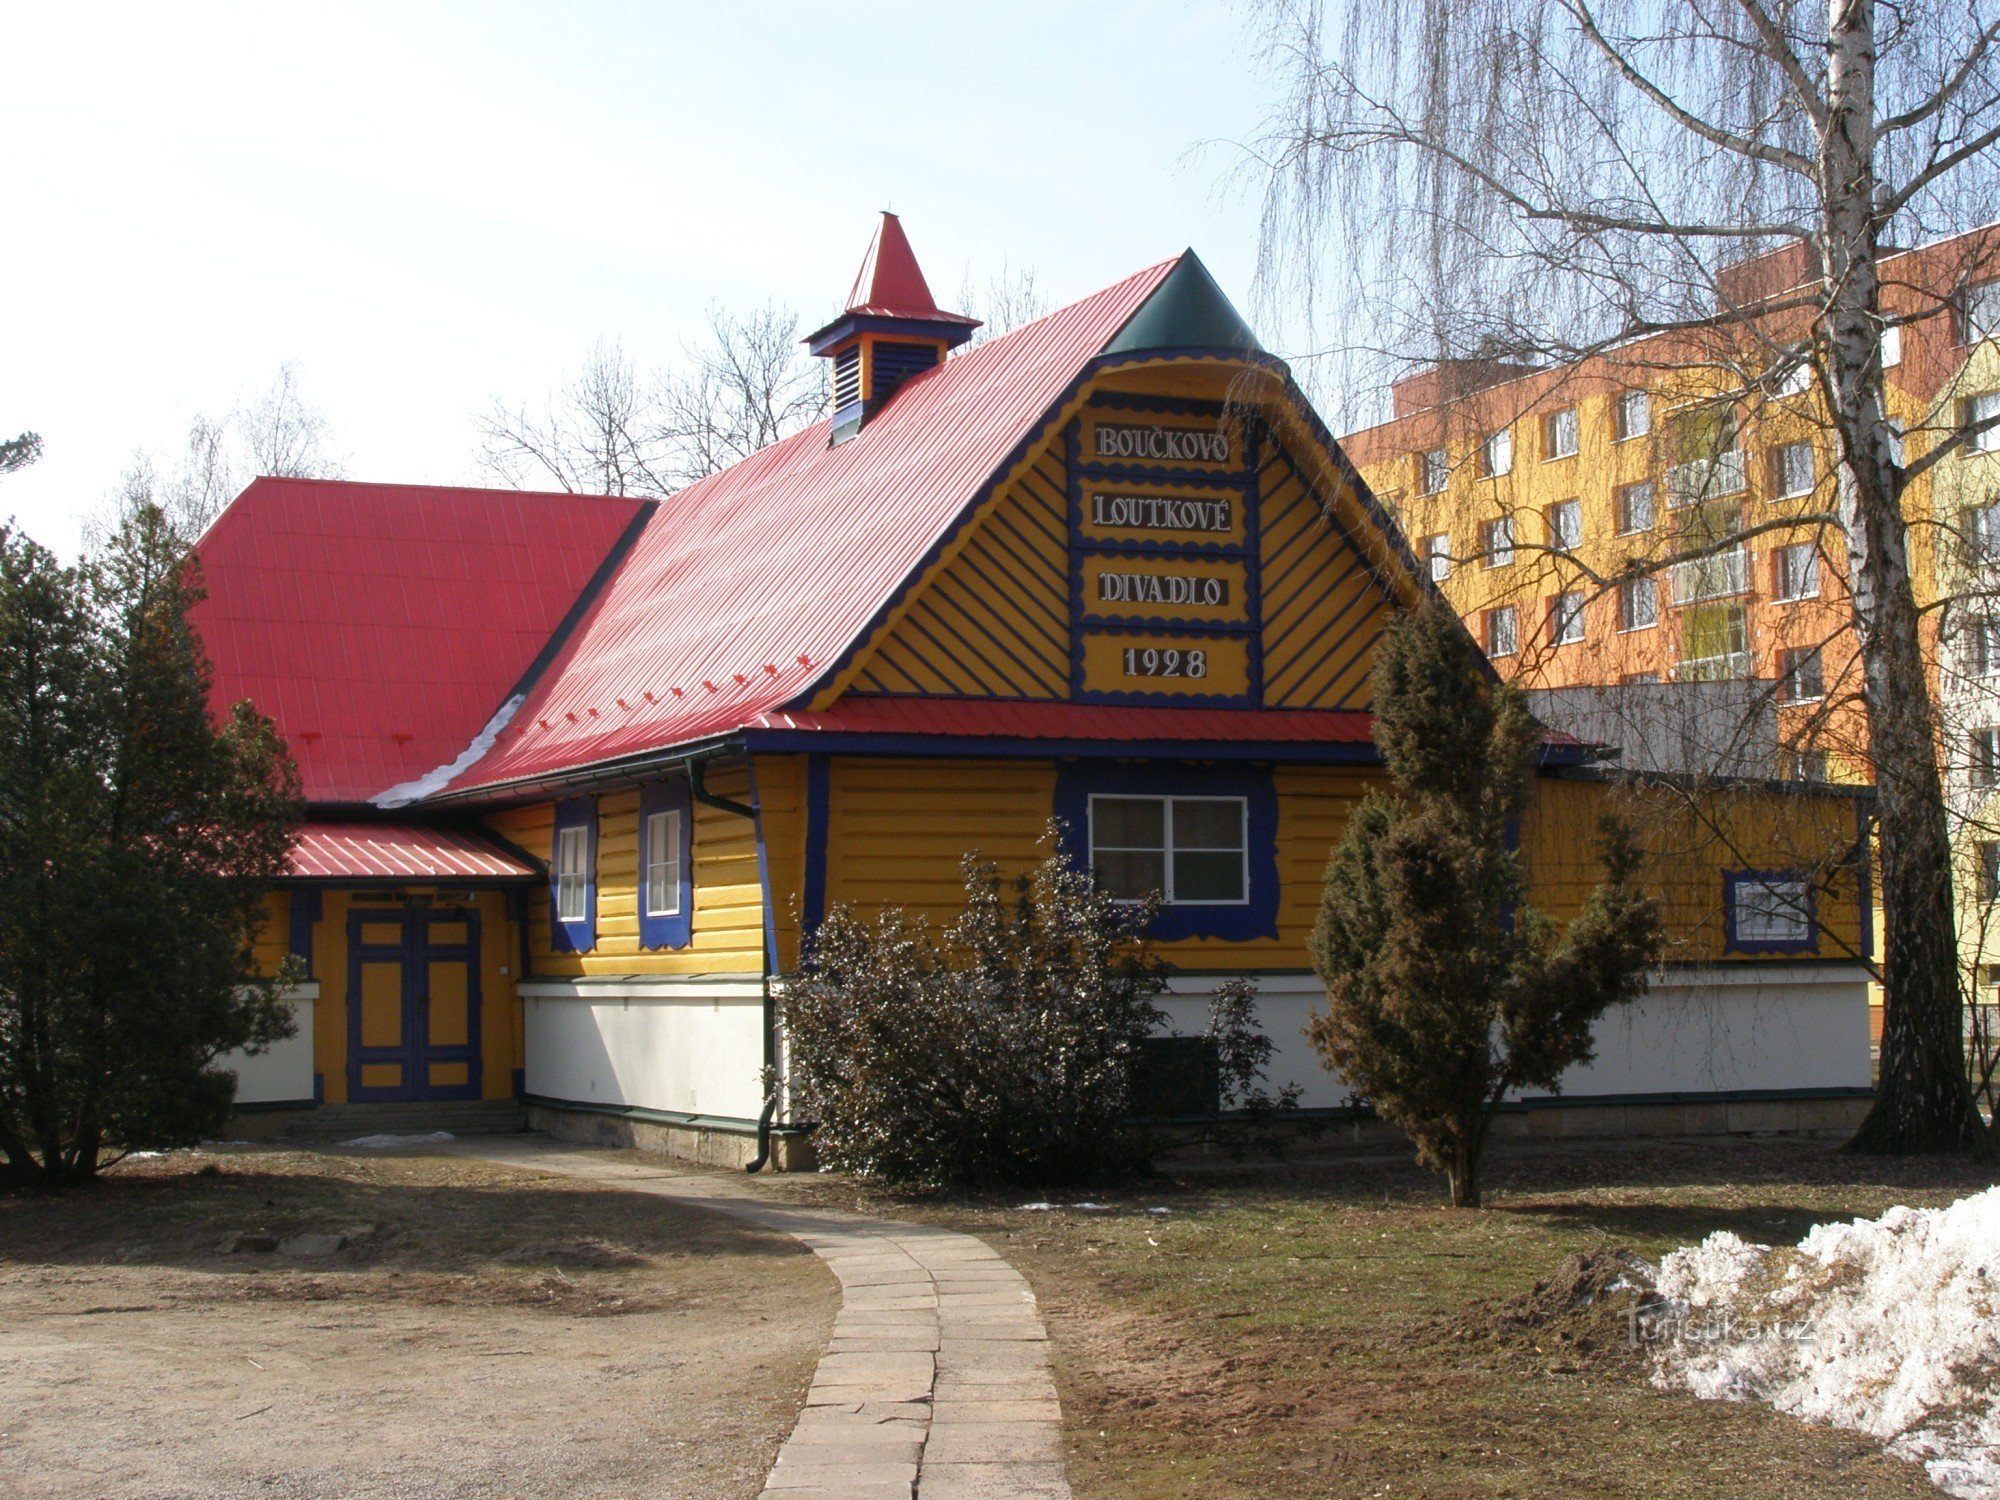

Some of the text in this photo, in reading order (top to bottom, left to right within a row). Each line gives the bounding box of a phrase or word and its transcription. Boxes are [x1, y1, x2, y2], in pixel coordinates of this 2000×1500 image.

[1096, 427, 1228, 460] BOUČKOVO
[1094, 496, 1231, 531] LOUTKOVÉ
[1099, 573, 1221, 605] DIVADLO
[1126, 648, 1206, 678] 1928
